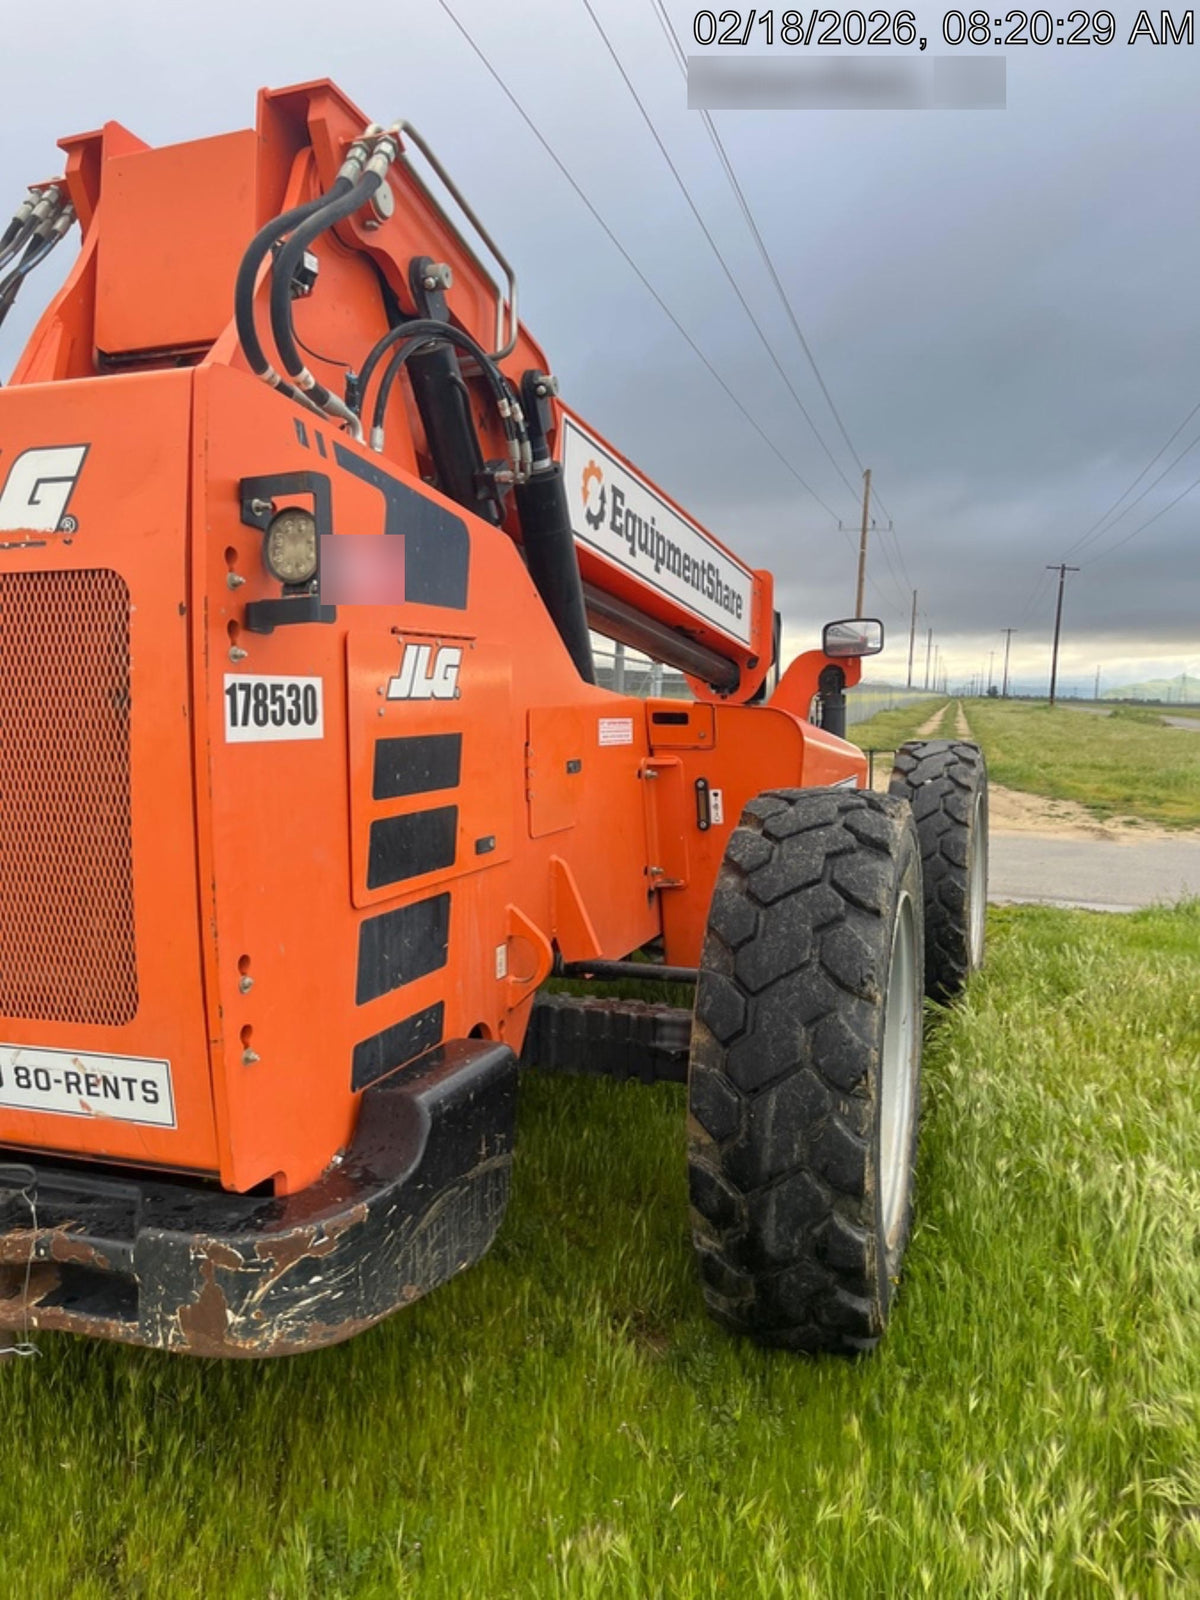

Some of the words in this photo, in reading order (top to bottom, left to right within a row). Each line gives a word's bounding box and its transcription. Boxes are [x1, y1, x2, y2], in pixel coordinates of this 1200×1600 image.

[0, 443, 91, 533] G
[609, 484, 744, 620] EquipmentShare
[386, 643, 463, 701] JLG
[225, 682, 318, 727] 178530
[14, 1066, 160, 1104] 80-RENTS
